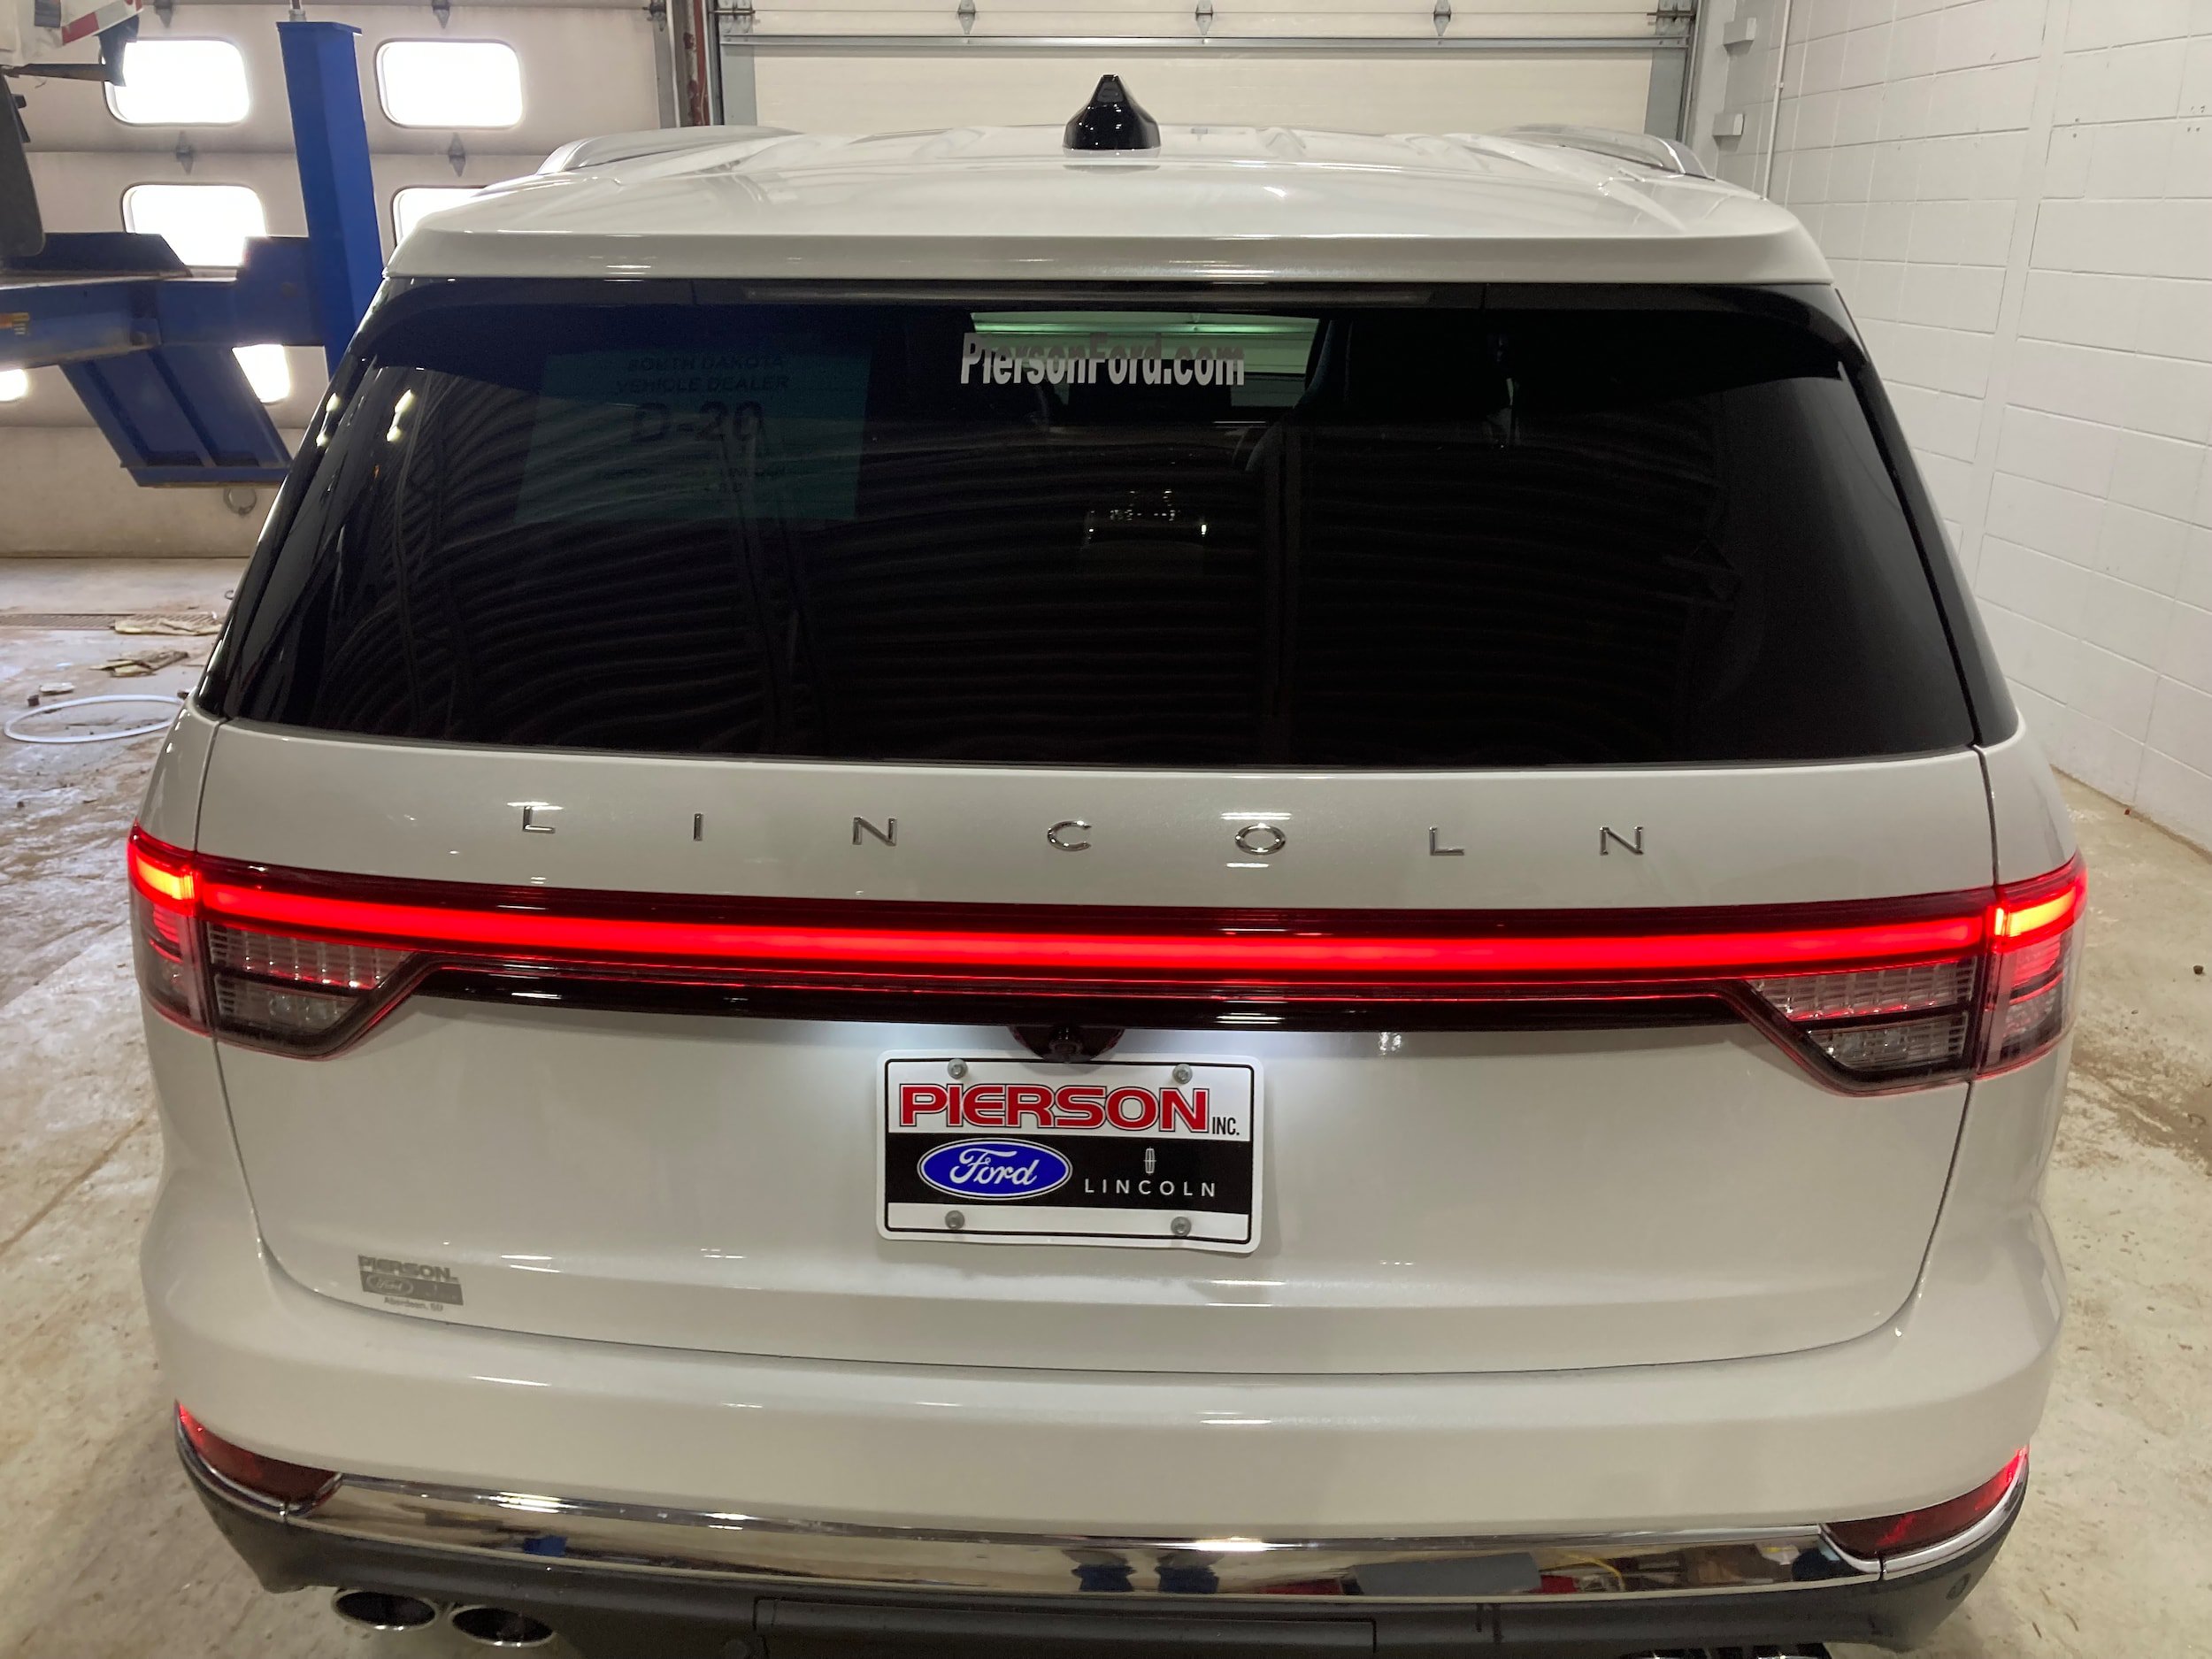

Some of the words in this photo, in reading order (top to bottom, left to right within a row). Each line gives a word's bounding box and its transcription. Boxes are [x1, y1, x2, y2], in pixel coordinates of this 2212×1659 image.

[627, 357, 695, 372] SOUTH
[702, 355, 784, 370] DAKOTA
[961, 333, 1245, 386] PiersonFord.com
[617, 376, 703, 394] VEHICLE
[707, 374, 791, 392] DEALER
[521, 804, 1645, 856] LINCOLN
[899, 1082, 1210, 1133] PIERSON
[1211, 1116, 1240, 1136] INC.
[949, 1147, 1041, 1187] Ford
[1084, 1179, 1217, 1198] LINCOLN
